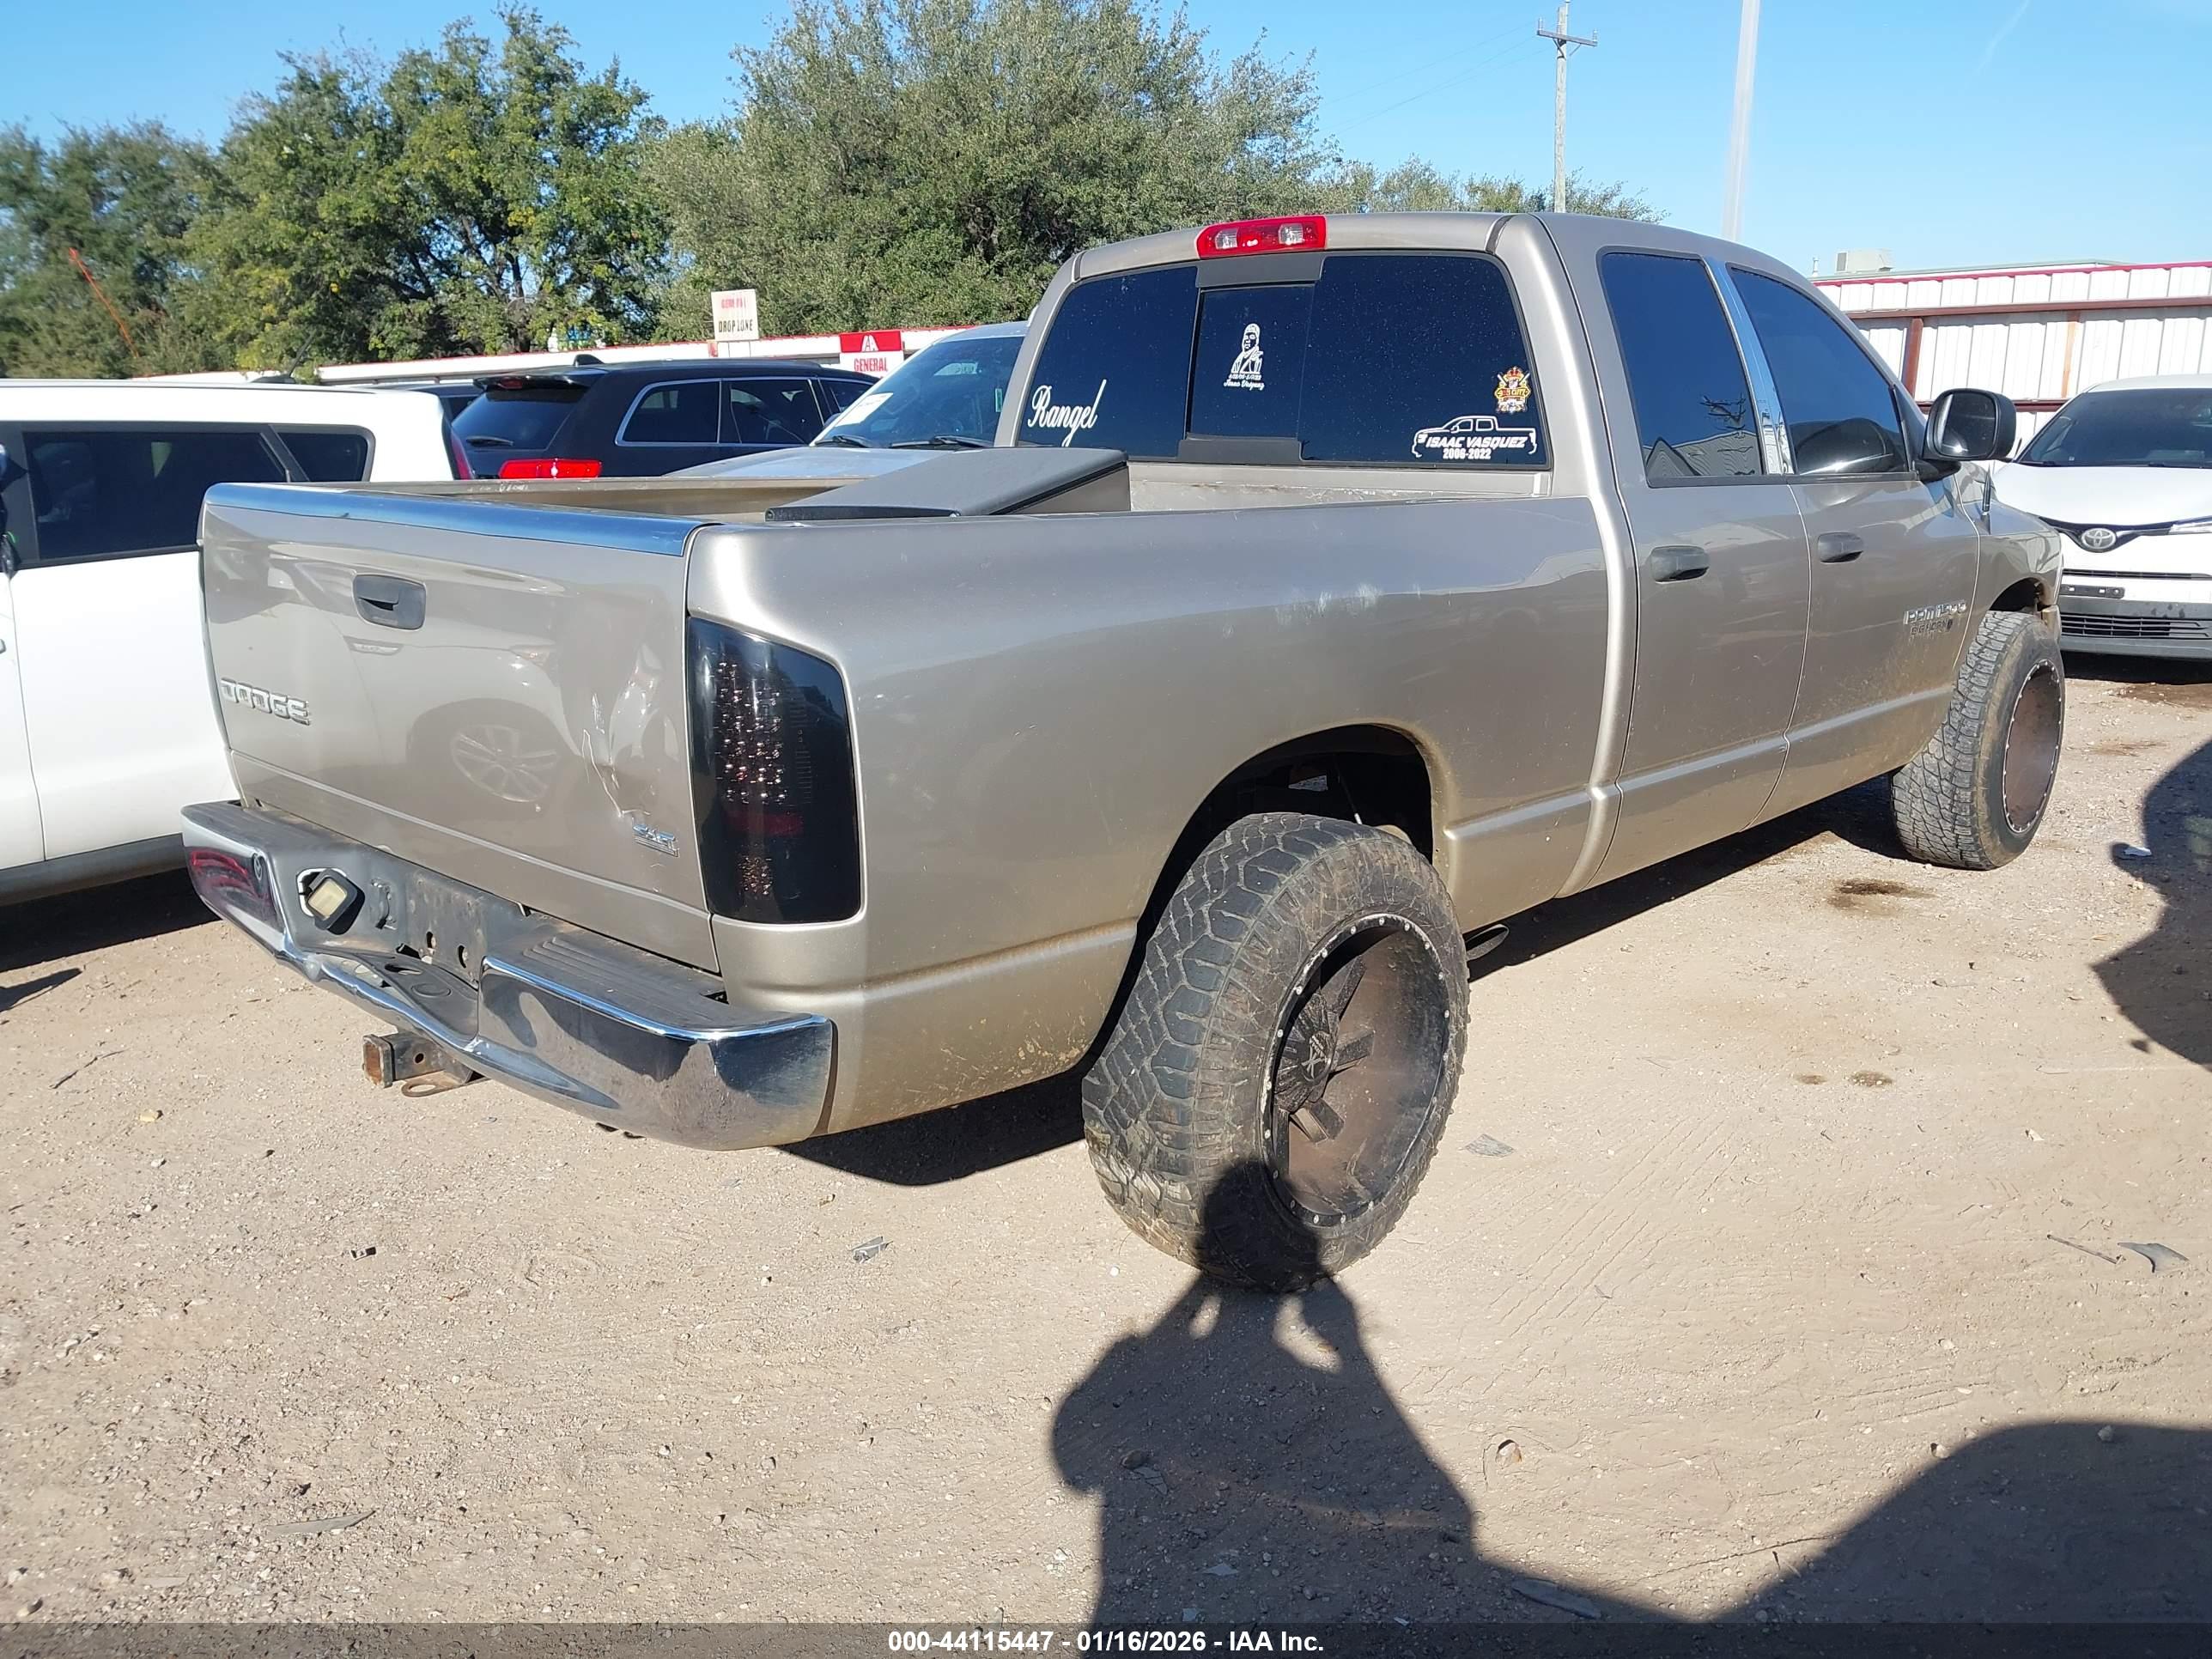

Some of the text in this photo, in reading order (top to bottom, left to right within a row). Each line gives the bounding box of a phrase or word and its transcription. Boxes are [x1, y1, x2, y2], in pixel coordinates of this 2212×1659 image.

[718, 319, 736, 333] DROP
[854, 357, 888, 372] GENERAL
[1028, 379, 1107, 447] Rangel
[1425, 436, 1528, 450] ISAAC VASQUEZ
[1443, 447, 1492, 459] 2006-2022
[221, 677, 310, 726] DODGE
